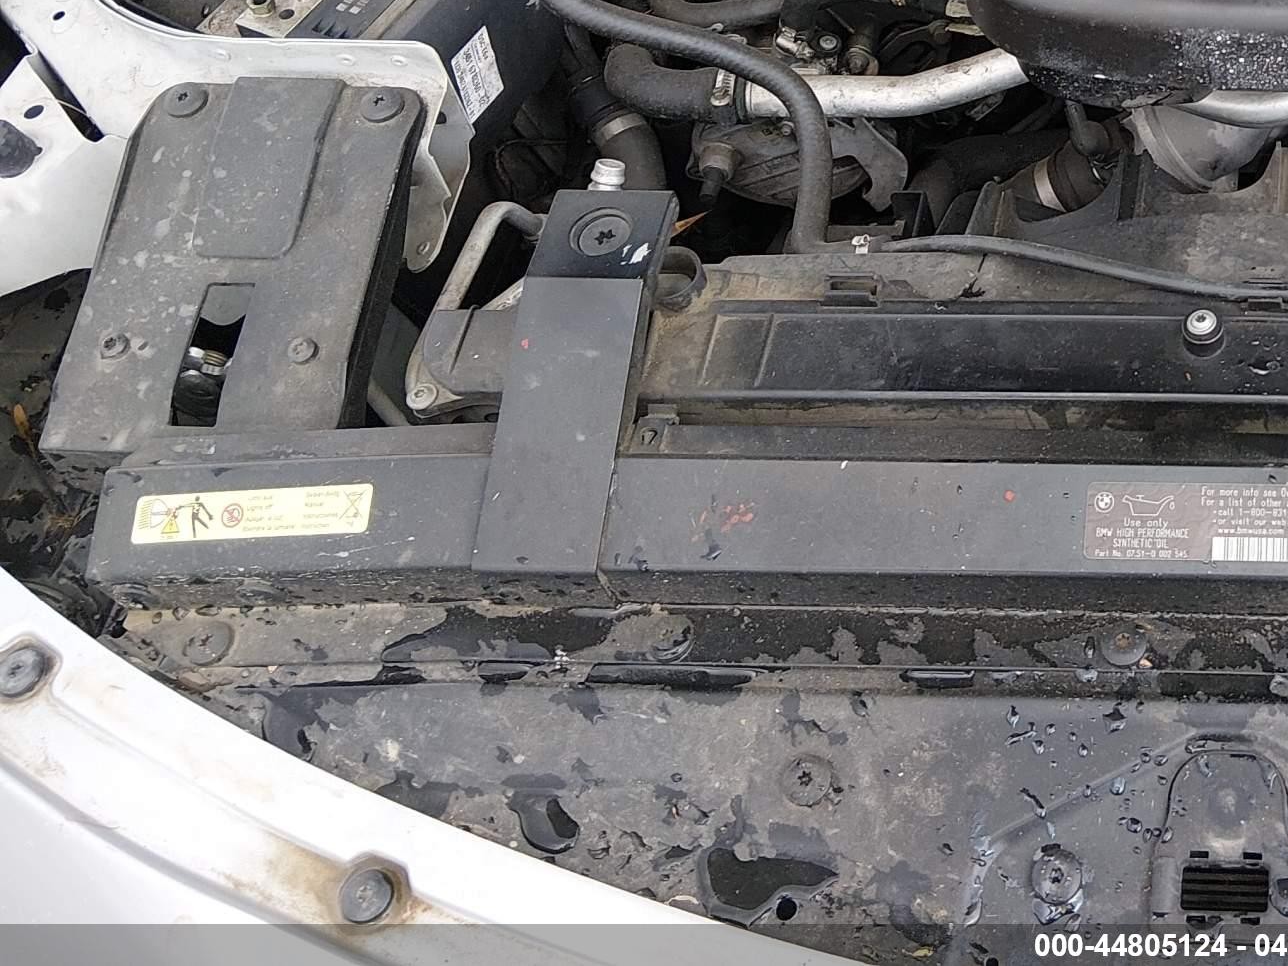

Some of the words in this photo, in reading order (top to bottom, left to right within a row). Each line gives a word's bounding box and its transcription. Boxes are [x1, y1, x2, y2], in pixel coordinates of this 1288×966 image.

[1201, 486, 1215, 497] For
[1219, 489, 1239, 497] more
[1242, 488, 1259, 497] info
[1263, 490, 1277, 498] see
[1201, 497, 1215, 507] For
[1228, 497, 1243, 507] list
[1247, 497, 1257, 507] of
[1261, 498, 1282, 507] other
[1123, 517, 1141, 527] Use
[1147, 518, 1168, 529] only
[1231, 518, 1250, 526] visit
[1271, 518, 1287, 526] web
[1096, 527, 1113, 537] BMW
[1117, 528, 1134, 538] HIGH
[1137, 528, 1190, 538] PERFORMANCE
[1217, 526, 1285, 535] www.bmwusa.com
[1113, 538, 1153, 548] SYNTHETIC
[1156, 539, 1169, 548] OIL
[1095, 549, 1109, 557] Part
